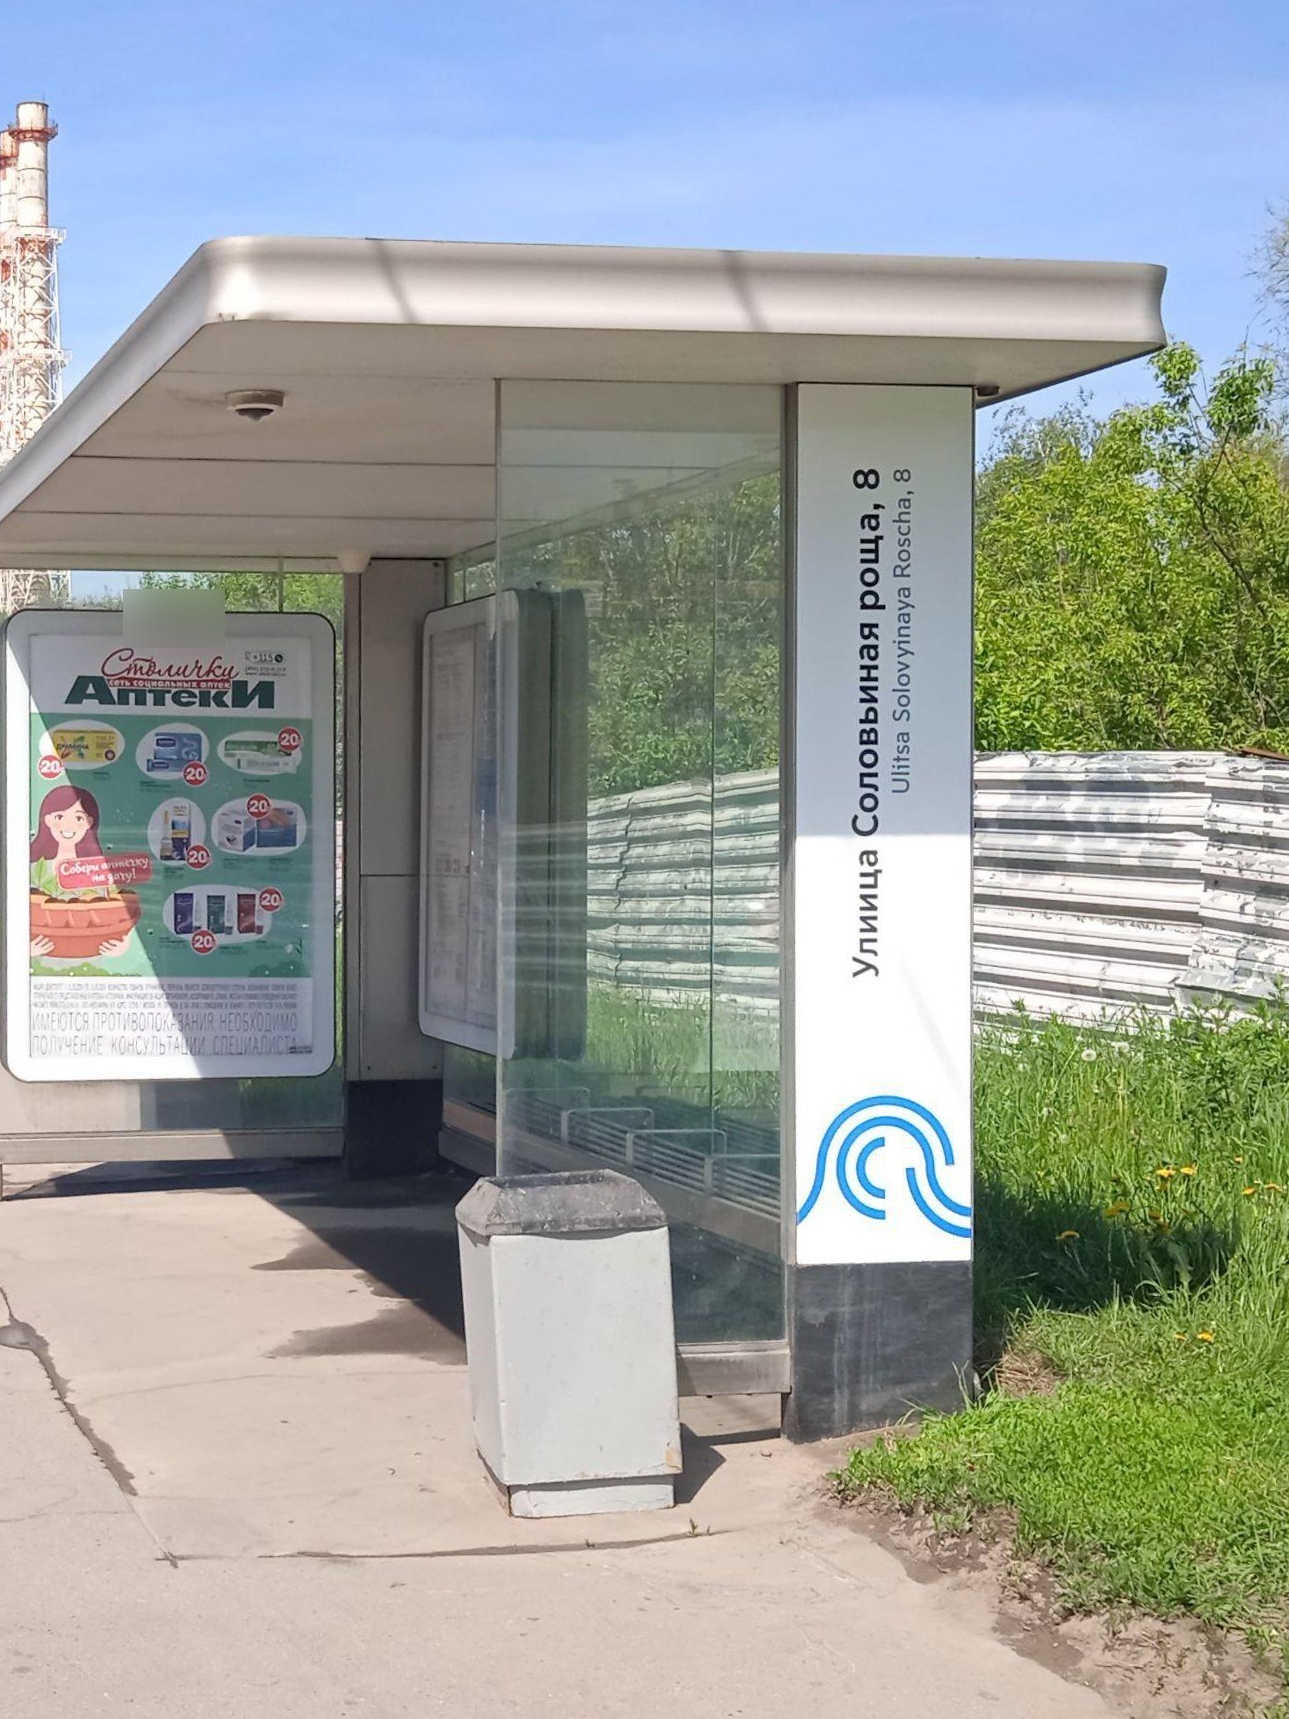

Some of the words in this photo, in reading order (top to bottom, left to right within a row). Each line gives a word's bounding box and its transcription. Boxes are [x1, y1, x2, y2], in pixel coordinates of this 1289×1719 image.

[852, 468, 881, 490] 8
[893, 468, 911, 483] 8
[892, 490, 915, 578] Roscha,
[858, 503, 887, 611] роща,
[892, 586, 916, 722] Solovyinaya
[101, 648, 238, 679] Столички
[133, 680, 197, 689] социальных
[200, 681, 230, 689] аптек
[851, 622, 880, 838] Соловьиная
[279, 732, 298, 746] 20
[40, 760, 61, 773] 20
[891, 731, 911, 794] Ulitsa
[185, 766, 206, 780] 20
[249, 799, 268, 813] 20
[188, 850, 208, 863] 20
[60, 861, 99, 875] Собери
[92, 873, 106, 883] на
[261, 893, 280, 906] 20
[851, 849, 883, 979] Улиица
[194, 934, 213, 948] 20
[33, 1011, 89, 1032] ИМЕЮТСЯ
[93, 1011, 214, 1032] ПРОТИВОПОКАЗАНИЯ
[220, 1011, 297, 1032] НЕОБХОДИМО
[33, 1035, 103, 1055] ПОЛУЧЕНИЕ
[111, 1034, 205, 1056] КОНСУЛЬТАЦИИ
